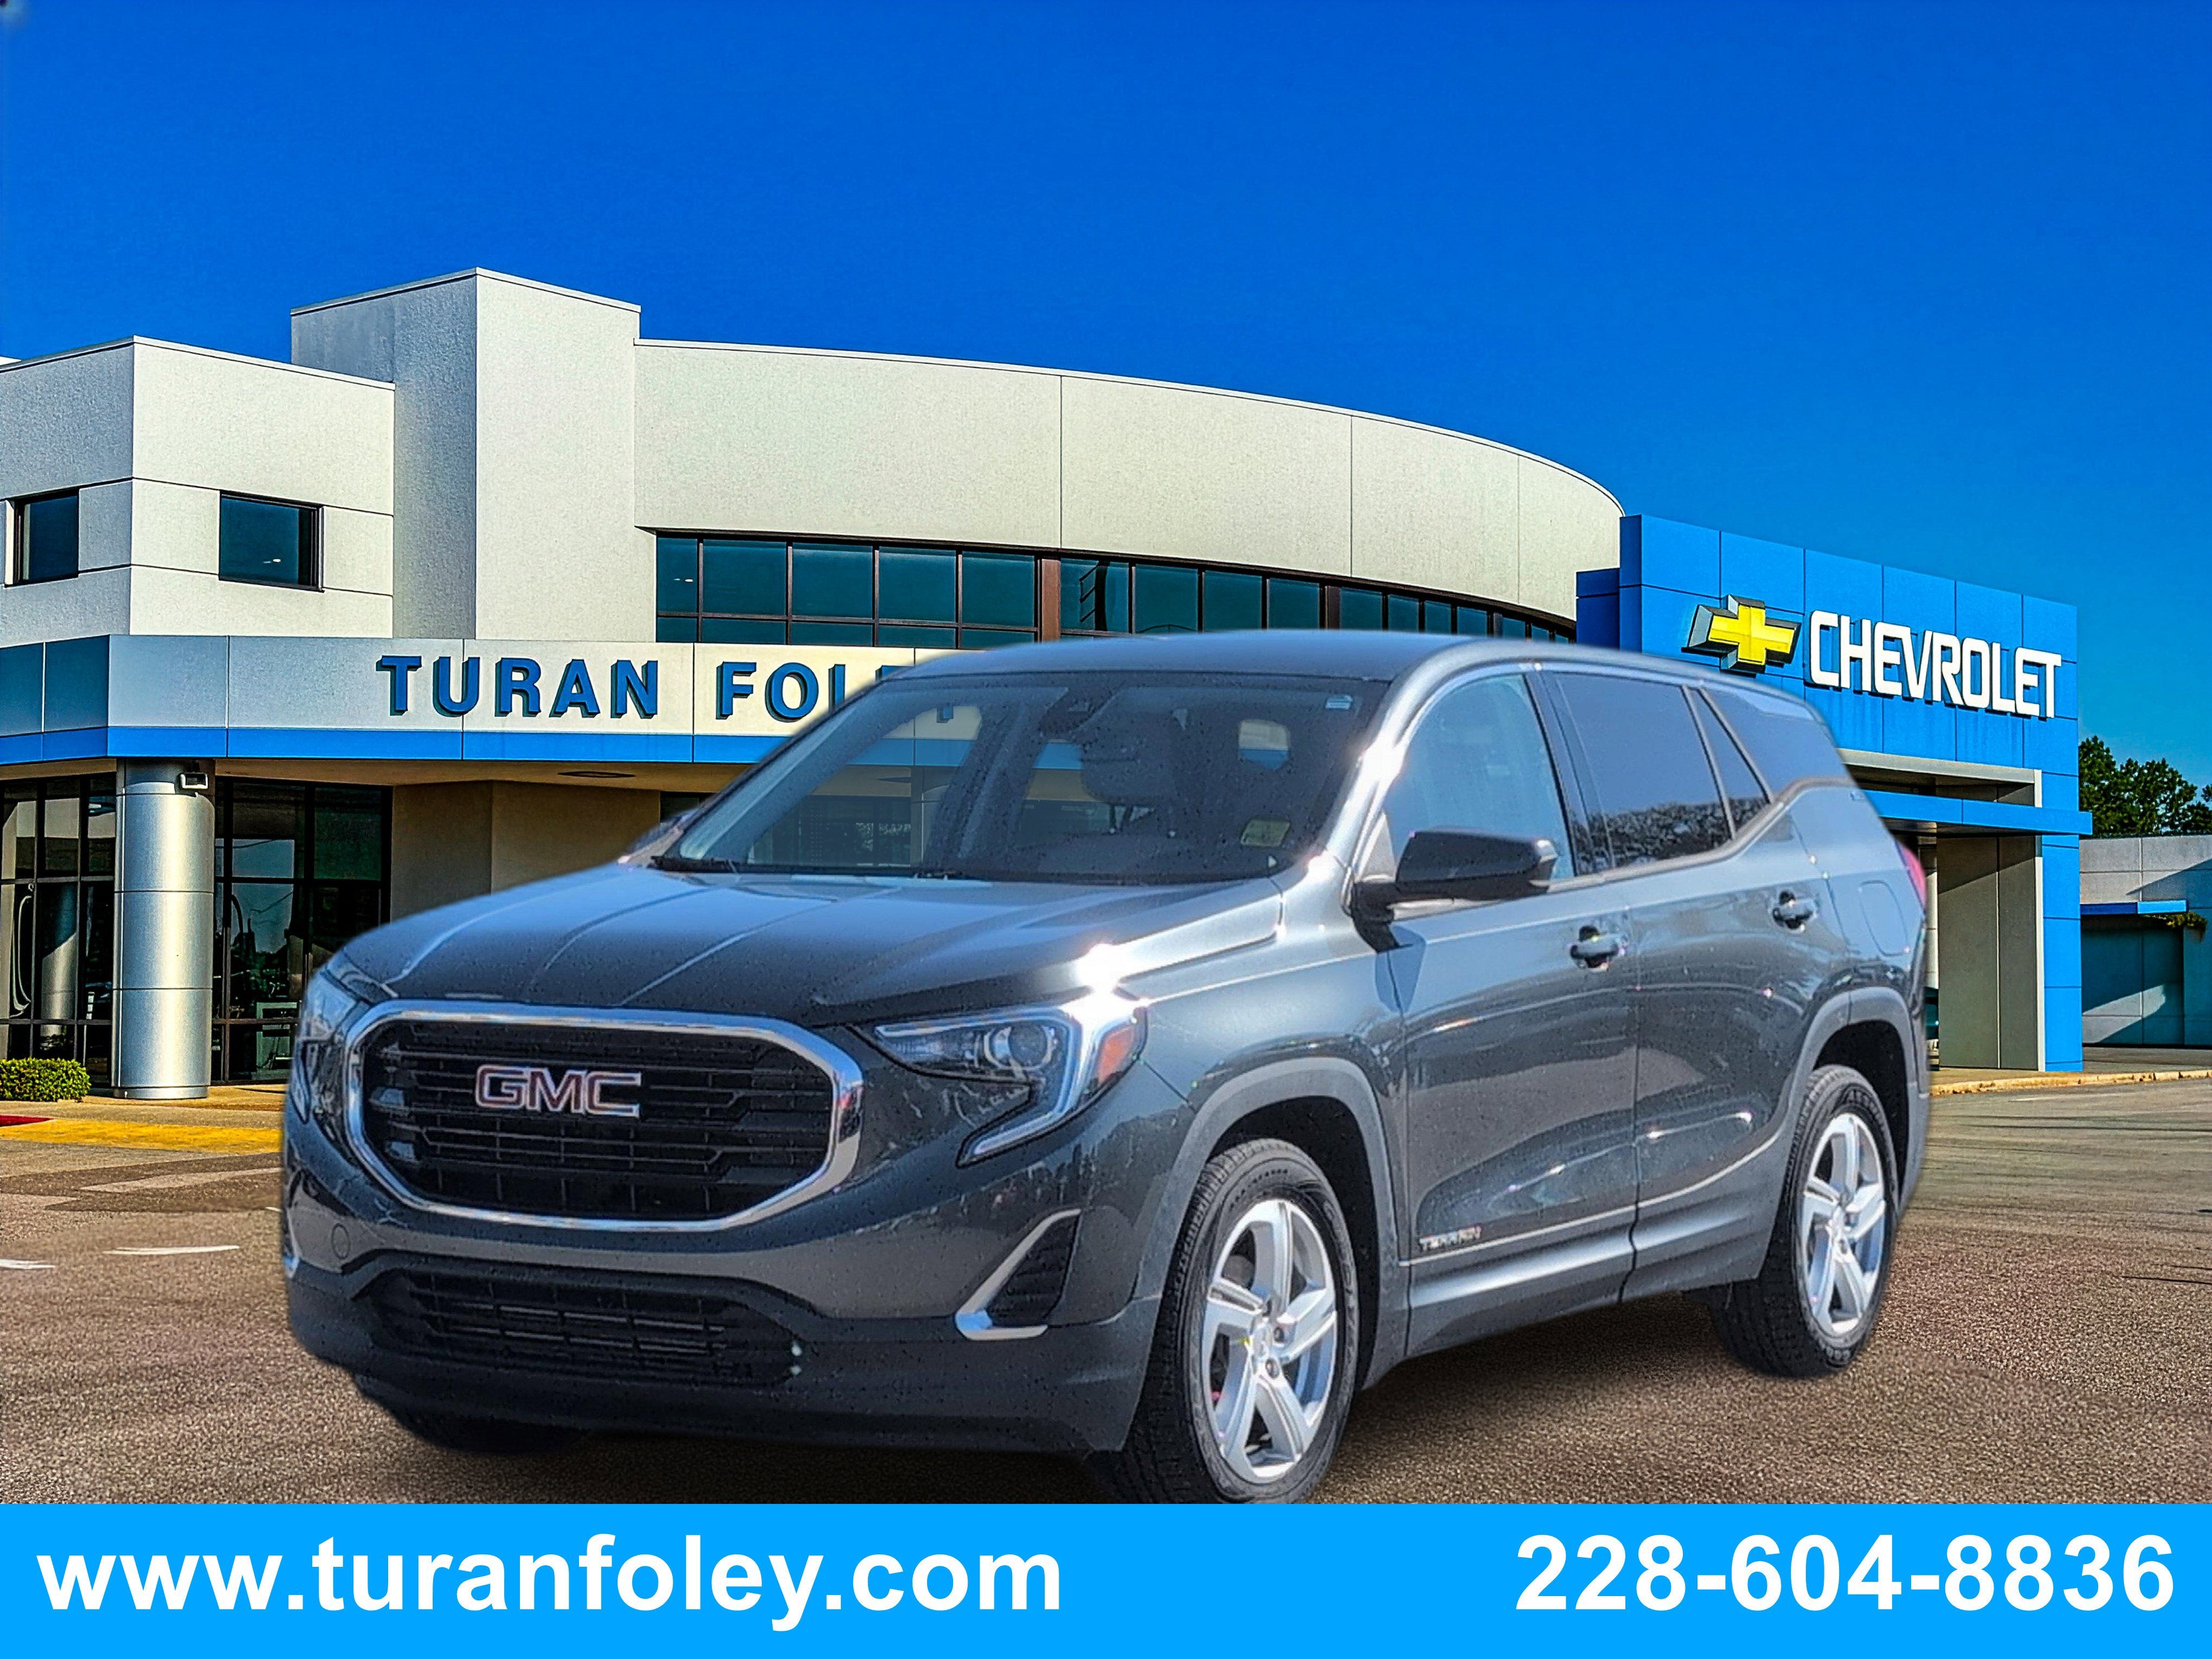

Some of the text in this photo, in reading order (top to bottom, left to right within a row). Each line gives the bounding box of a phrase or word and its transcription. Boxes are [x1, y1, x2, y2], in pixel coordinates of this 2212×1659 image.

[376, 655, 658, 719] TURAN
[1808, 609, 2062, 718] CHEVROLET
[475, 1064, 641, 1118] GMC
